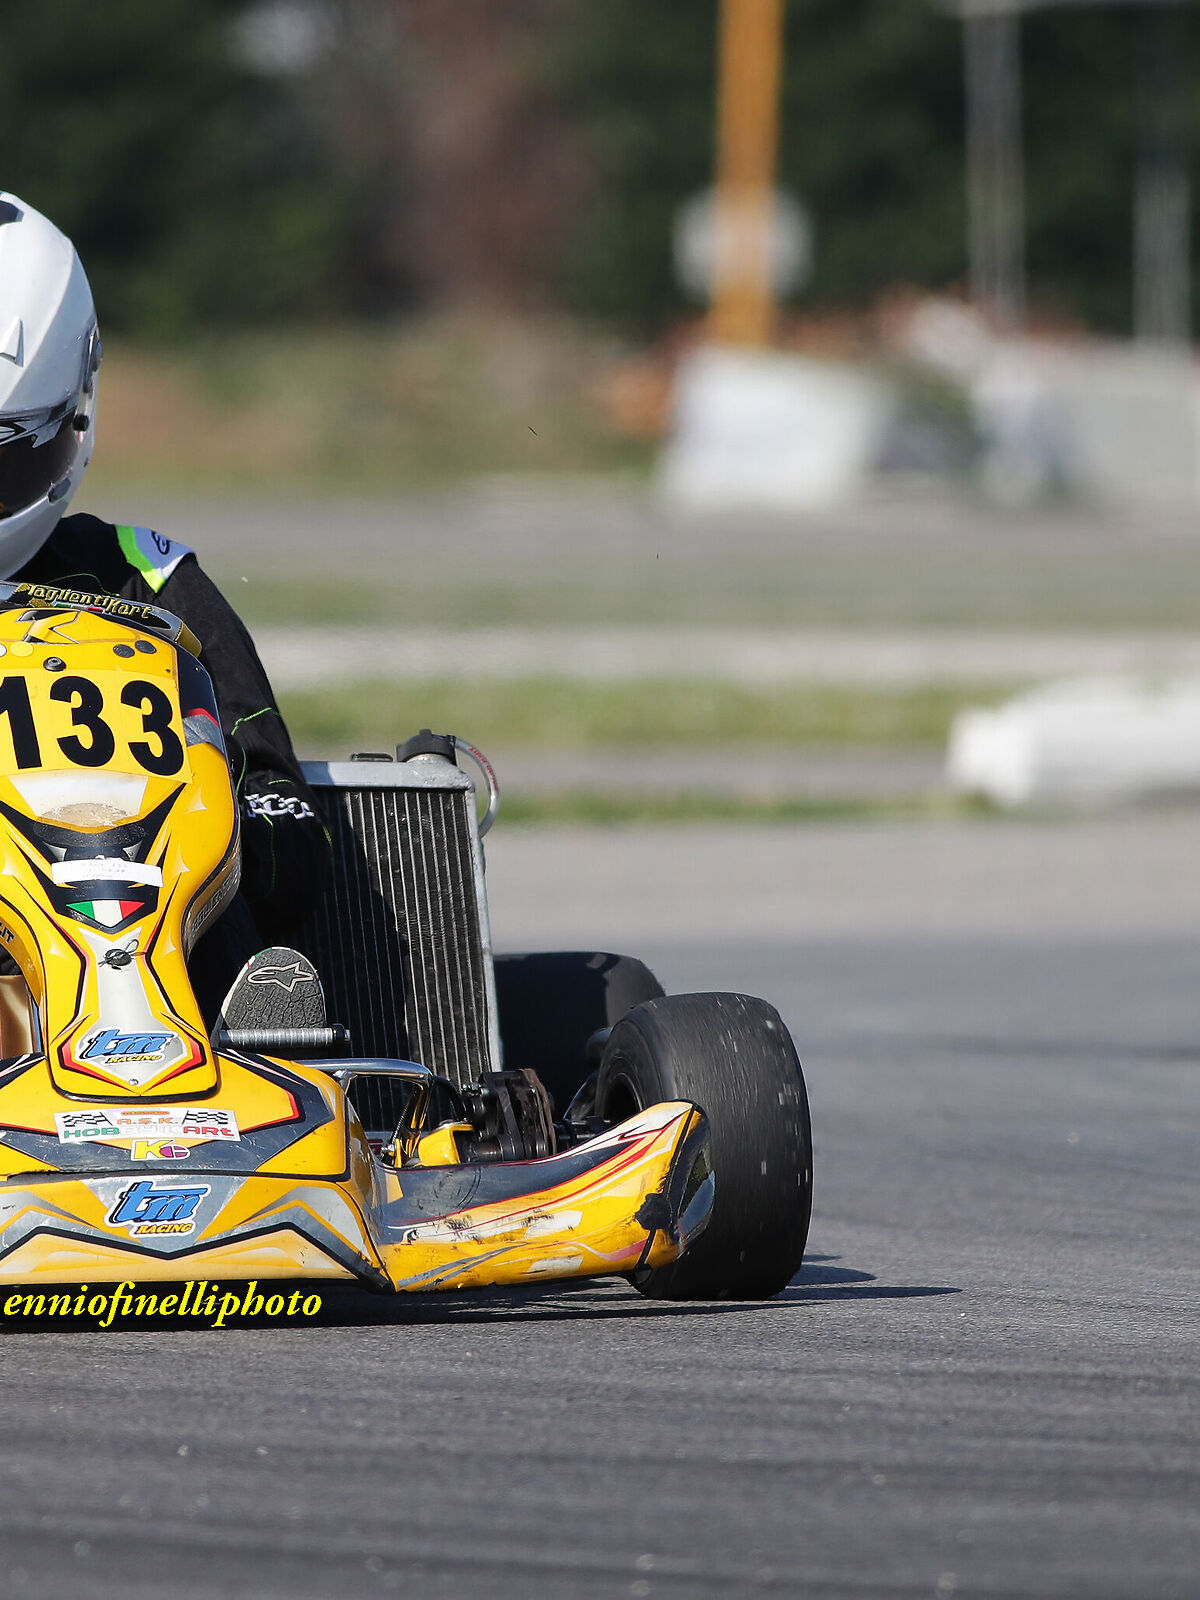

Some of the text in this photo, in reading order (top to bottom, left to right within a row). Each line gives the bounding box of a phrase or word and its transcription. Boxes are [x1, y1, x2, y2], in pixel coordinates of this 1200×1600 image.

[105, 1054, 163, 1064] RACING
[108, 1181, 209, 1224] tm
[134, 1222, 193, 1235] RACING
